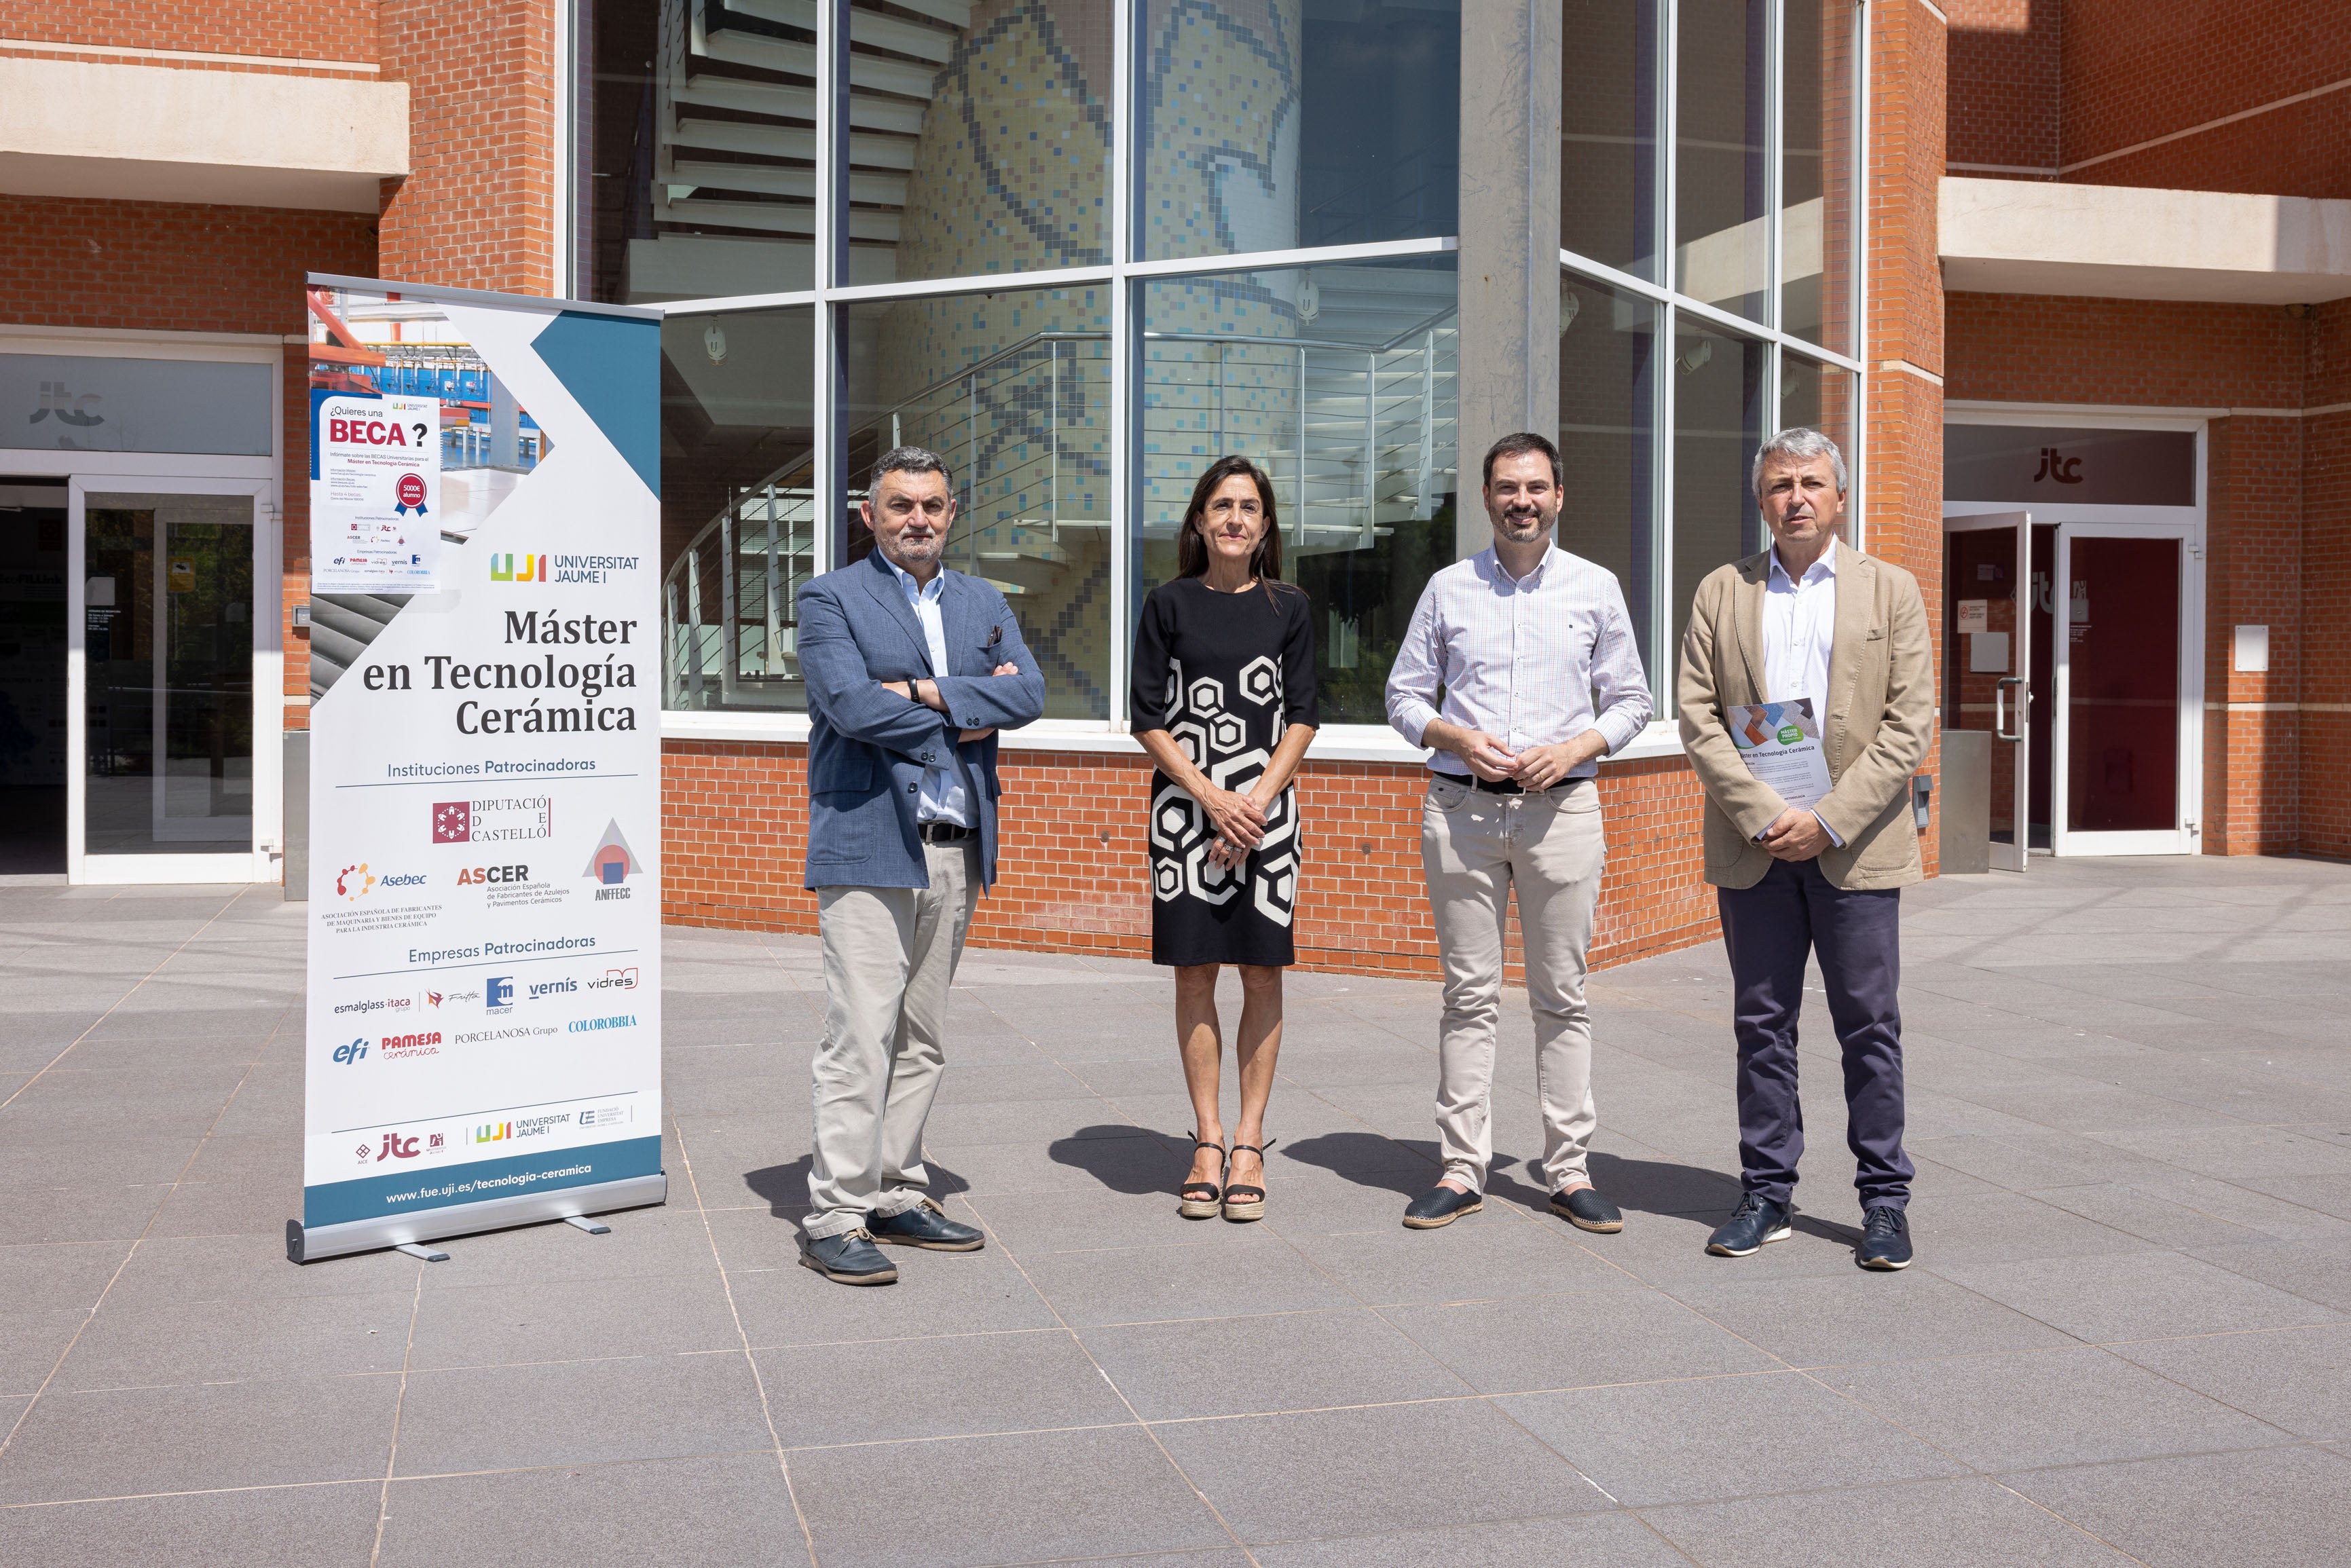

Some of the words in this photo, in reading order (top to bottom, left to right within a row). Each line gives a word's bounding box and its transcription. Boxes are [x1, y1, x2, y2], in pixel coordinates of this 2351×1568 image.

[331, 406, 366, 416] ¿Quieres
[330, 419, 407, 446] BECA
[412, 424, 428, 447] ?
[333, 557, 345, 565] efi
[555, 555, 640, 570] UNIVERSITAT
[554, 570, 599, 584] JAUME
[603, 572, 606, 584] I
[504, 609, 637, 644] Máster
[363, 663, 412, 690] en
[424, 654, 637, 698] Tecnología
[456, 698, 637, 735] Cerámica
[1759, 749, 1788, 758] Tecnología
[1789, 745, 1814, 753] Cerámica
[388, 762, 480, 778] Instituciones
[485, 758, 595, 774] Patrocinadoras
[472, 795, 547, 812] DIPUTACIÓ
[472, 816, 481, 827] D
[538, 813, 547, 824] E
[472, 824, 547, 842] CASTELLÓ
[380, 874, 427, 887] Asebec
[457, 865, 529, 886] ASCER
[523, 882, 550, 891] Española
[497, 891, 532, 899] Fabricantes
[595, 887, 630, 901] ANFFECC
[493, 899, 529, 908] Pavimentos
[320, 910, 358, 919] ASOCIACIÓN
[336, 918, 375, 926] MAQUINARIA
[409, 947, 479, 965] Empresas
[485, 937, 595, 956] Patrocinadoras
[529, 977, 577, 996] vernís
[587, 977, 633, 989] vidres
[448, 990, 481, 1003] Fritta
[486, 1007, 513, 1015] macer
[568, 1015, 637, 1033] COLOROBBIA
[382, 1032, 441, 1050] PAMESA
[455, 1027, 530, 1044] PORCELANOSA
[533, 1026, 558, 1036] Grupo
[333, 1038, 369, 1065] efi
[384, 1047, 439, 1060] cerámica
[516, 1113, 570, 1128] UNIVERSITAT
[516, 1126, 545, 1138] JAUME
[386, 1164, 591, 1203] www.fue.uji.es/tecnologia-ceramica
